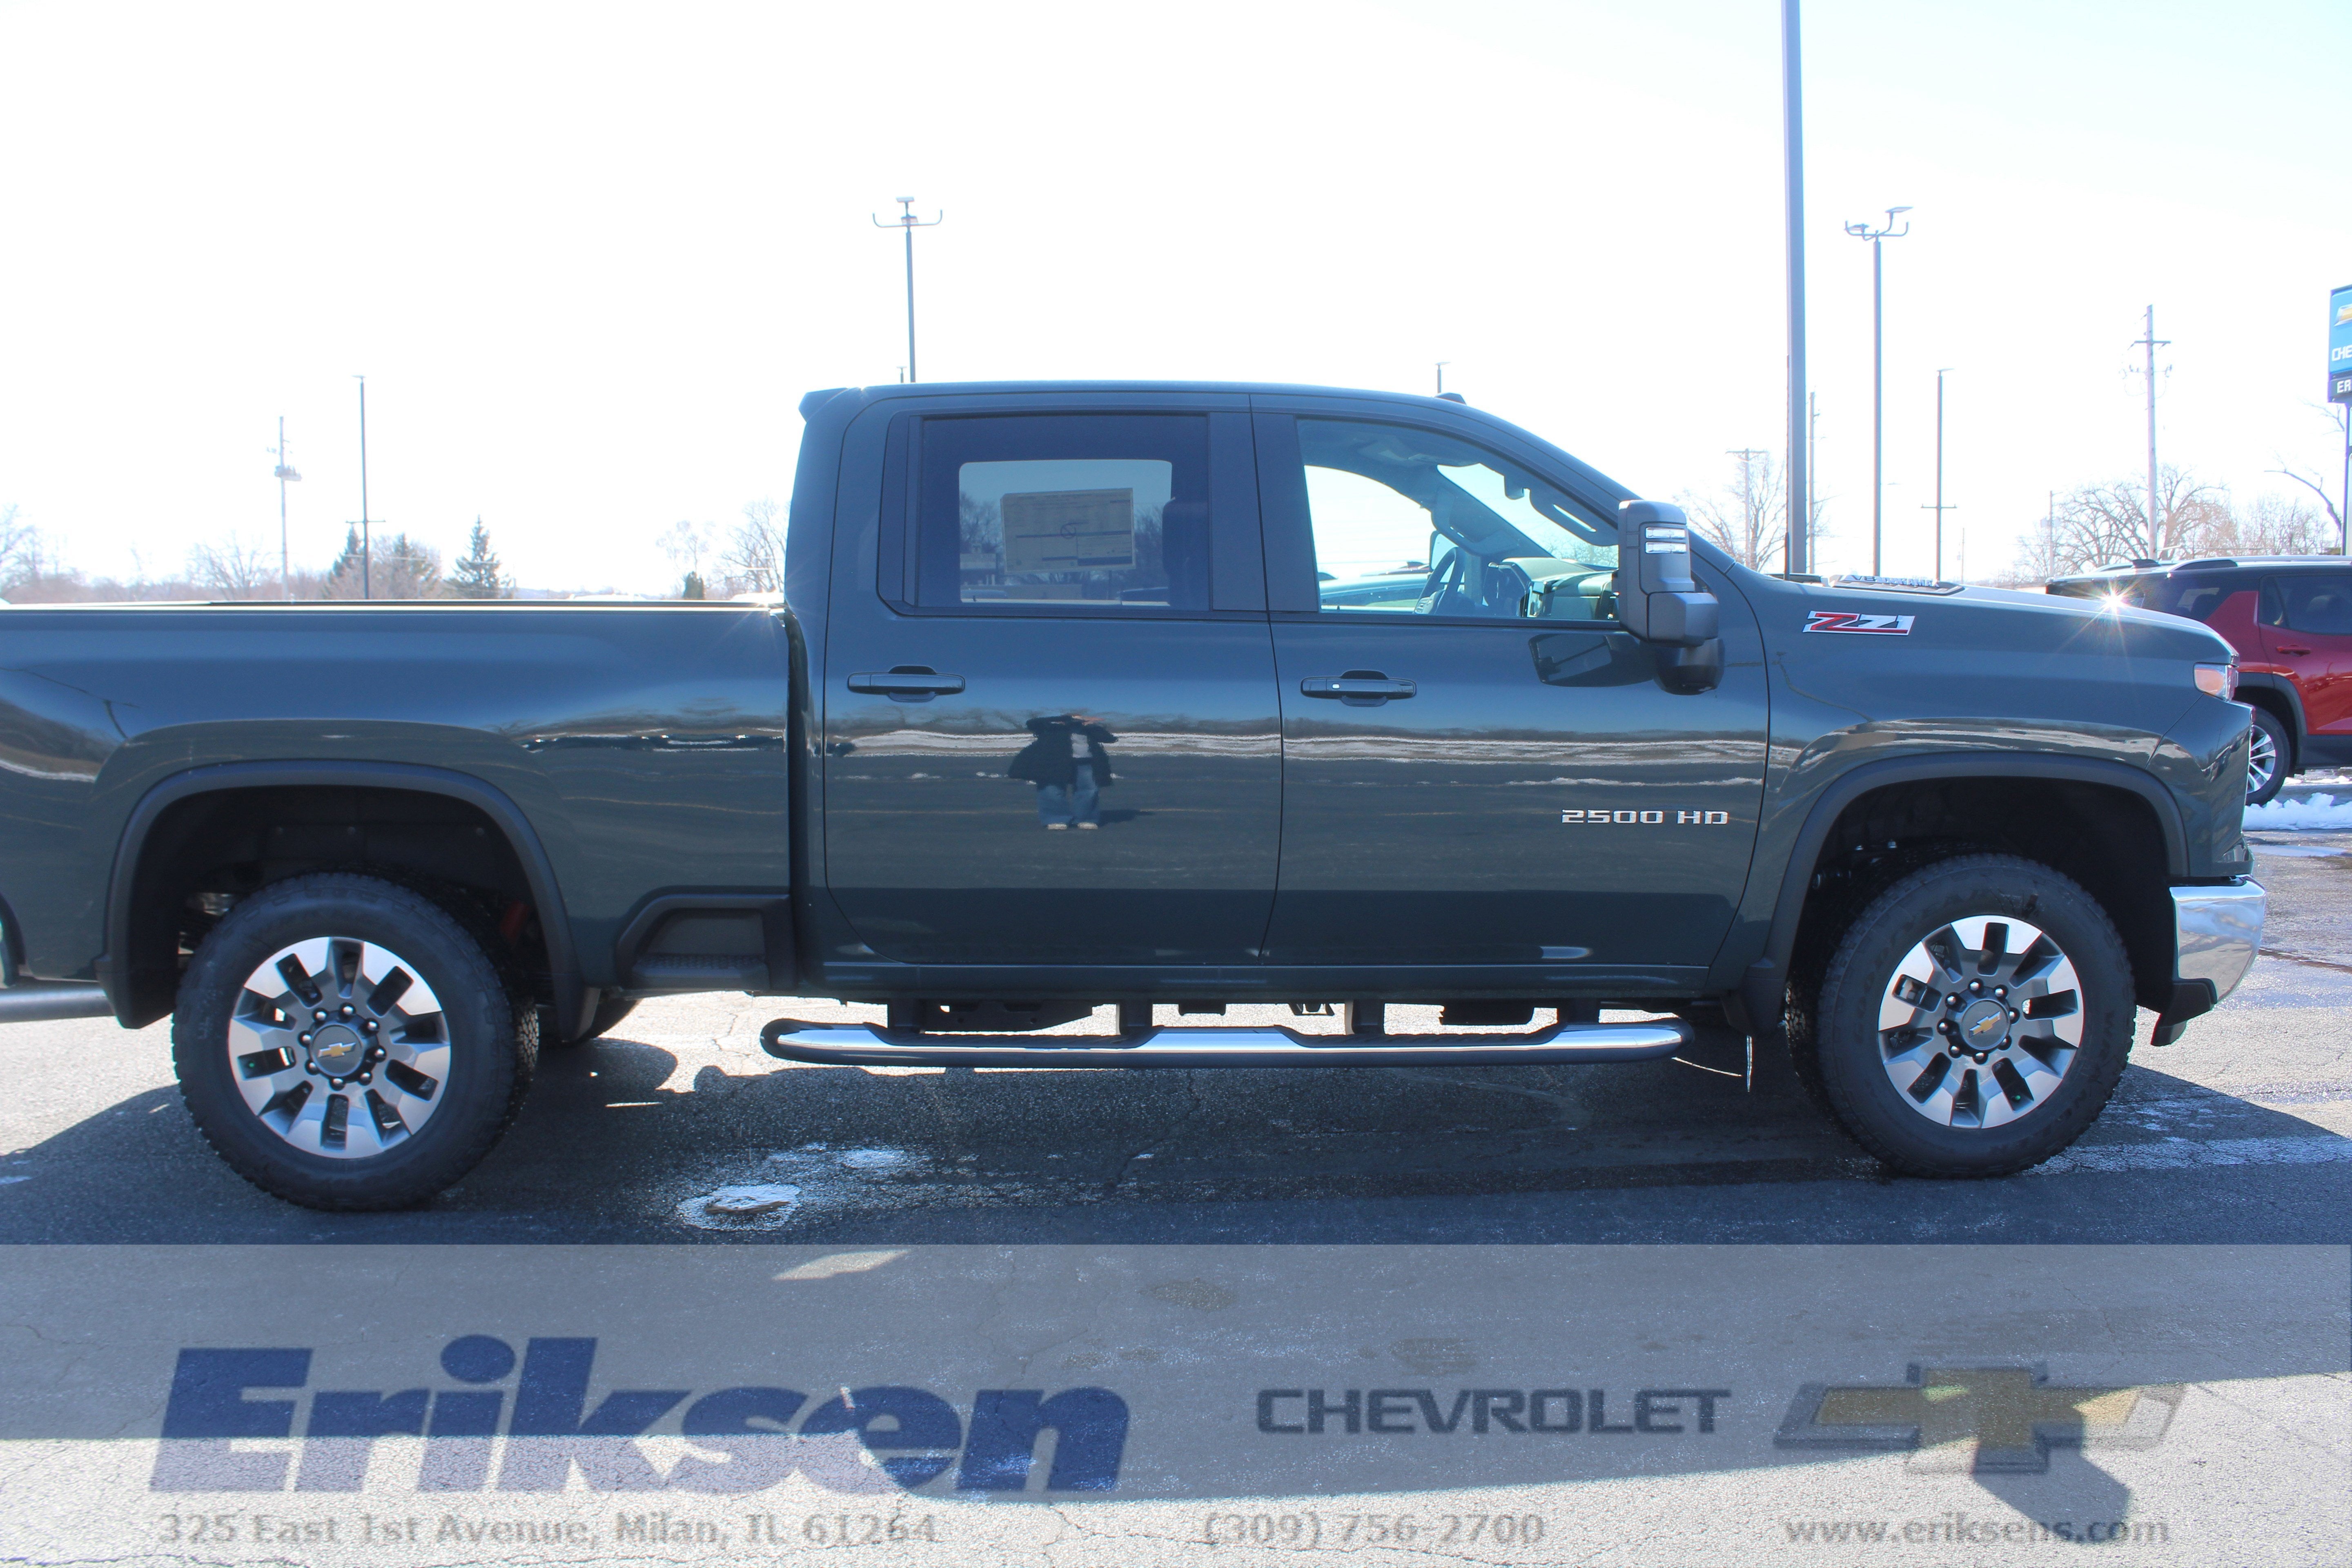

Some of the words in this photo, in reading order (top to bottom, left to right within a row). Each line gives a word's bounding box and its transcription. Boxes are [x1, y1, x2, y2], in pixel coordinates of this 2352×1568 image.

[1802, 611, 1915, 636] Z71
[1561, 809, 1664, 824] 2500
[1677, 810, 1729, 824] HD
